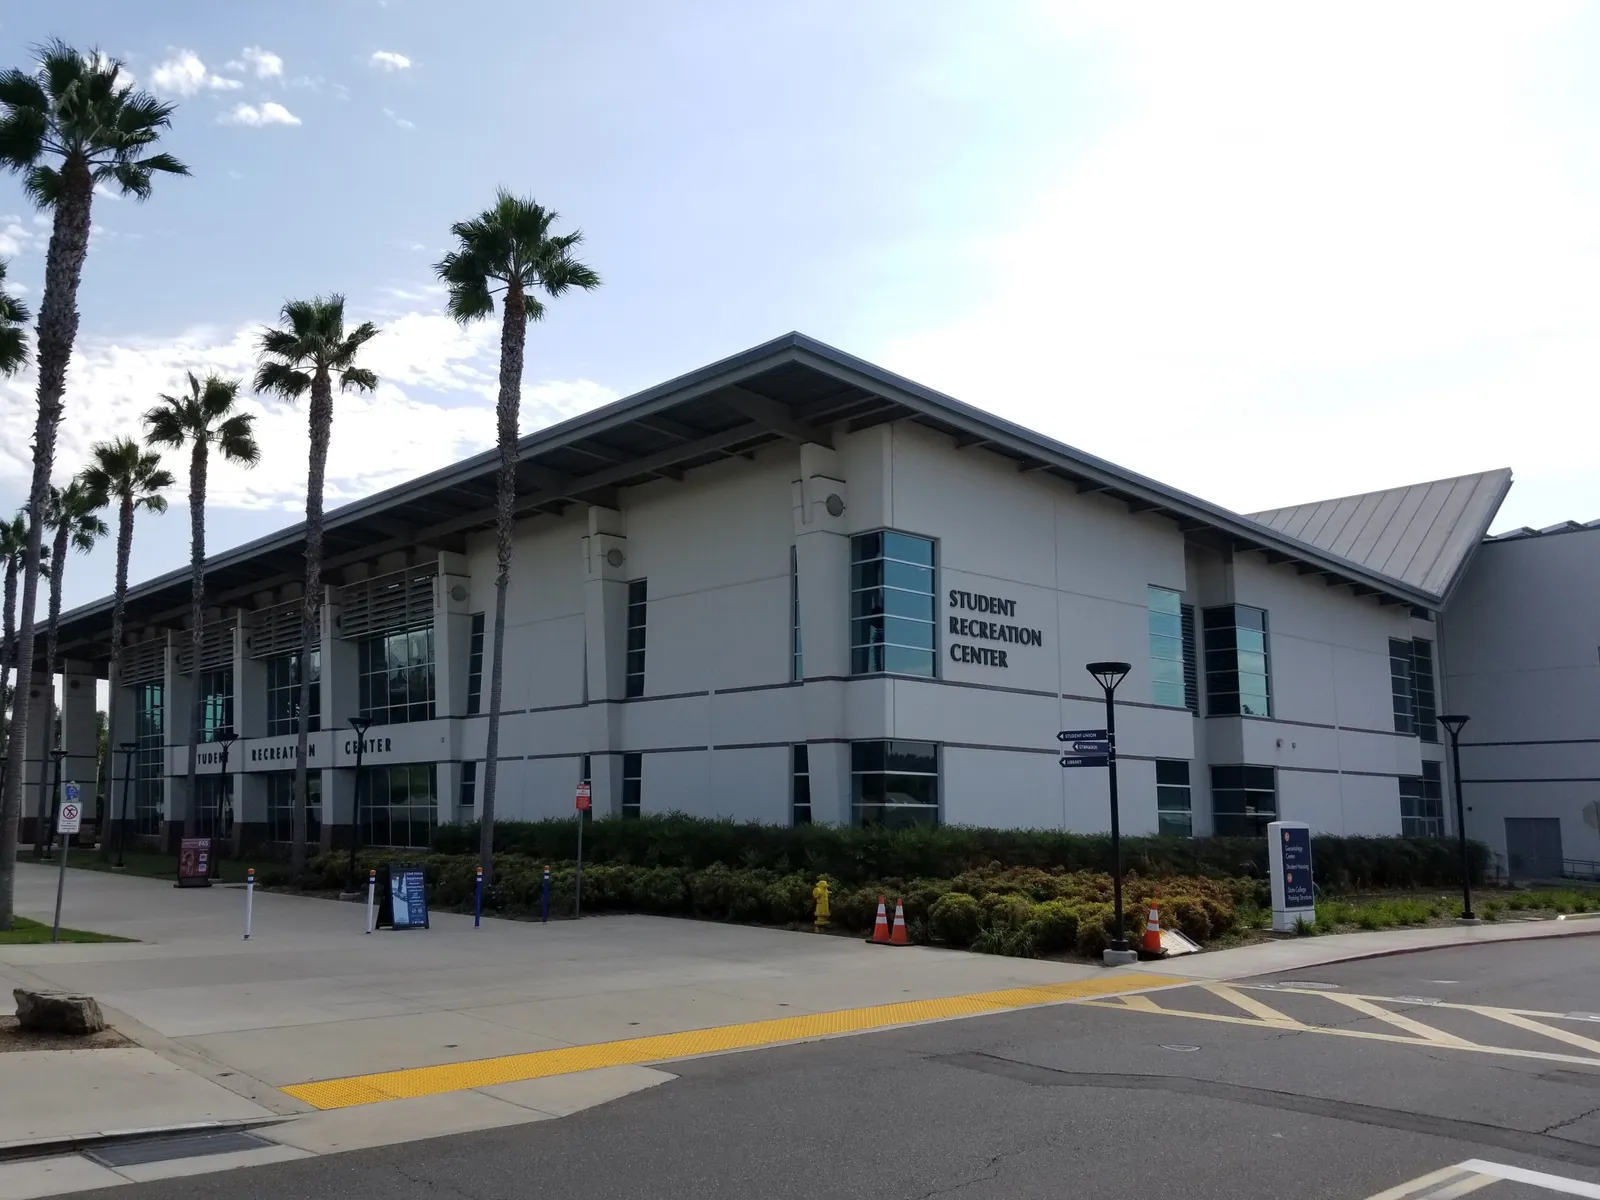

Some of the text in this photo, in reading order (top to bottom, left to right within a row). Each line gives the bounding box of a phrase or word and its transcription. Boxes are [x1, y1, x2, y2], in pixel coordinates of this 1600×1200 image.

[949, 589, 1017, 617] STUDENT
[949, 616, 1042, 647] RECREATION
[950, 643, 1008, 668] CENTER
[197, 738, 391, 765] TUDENT RECREATIN CENTER
